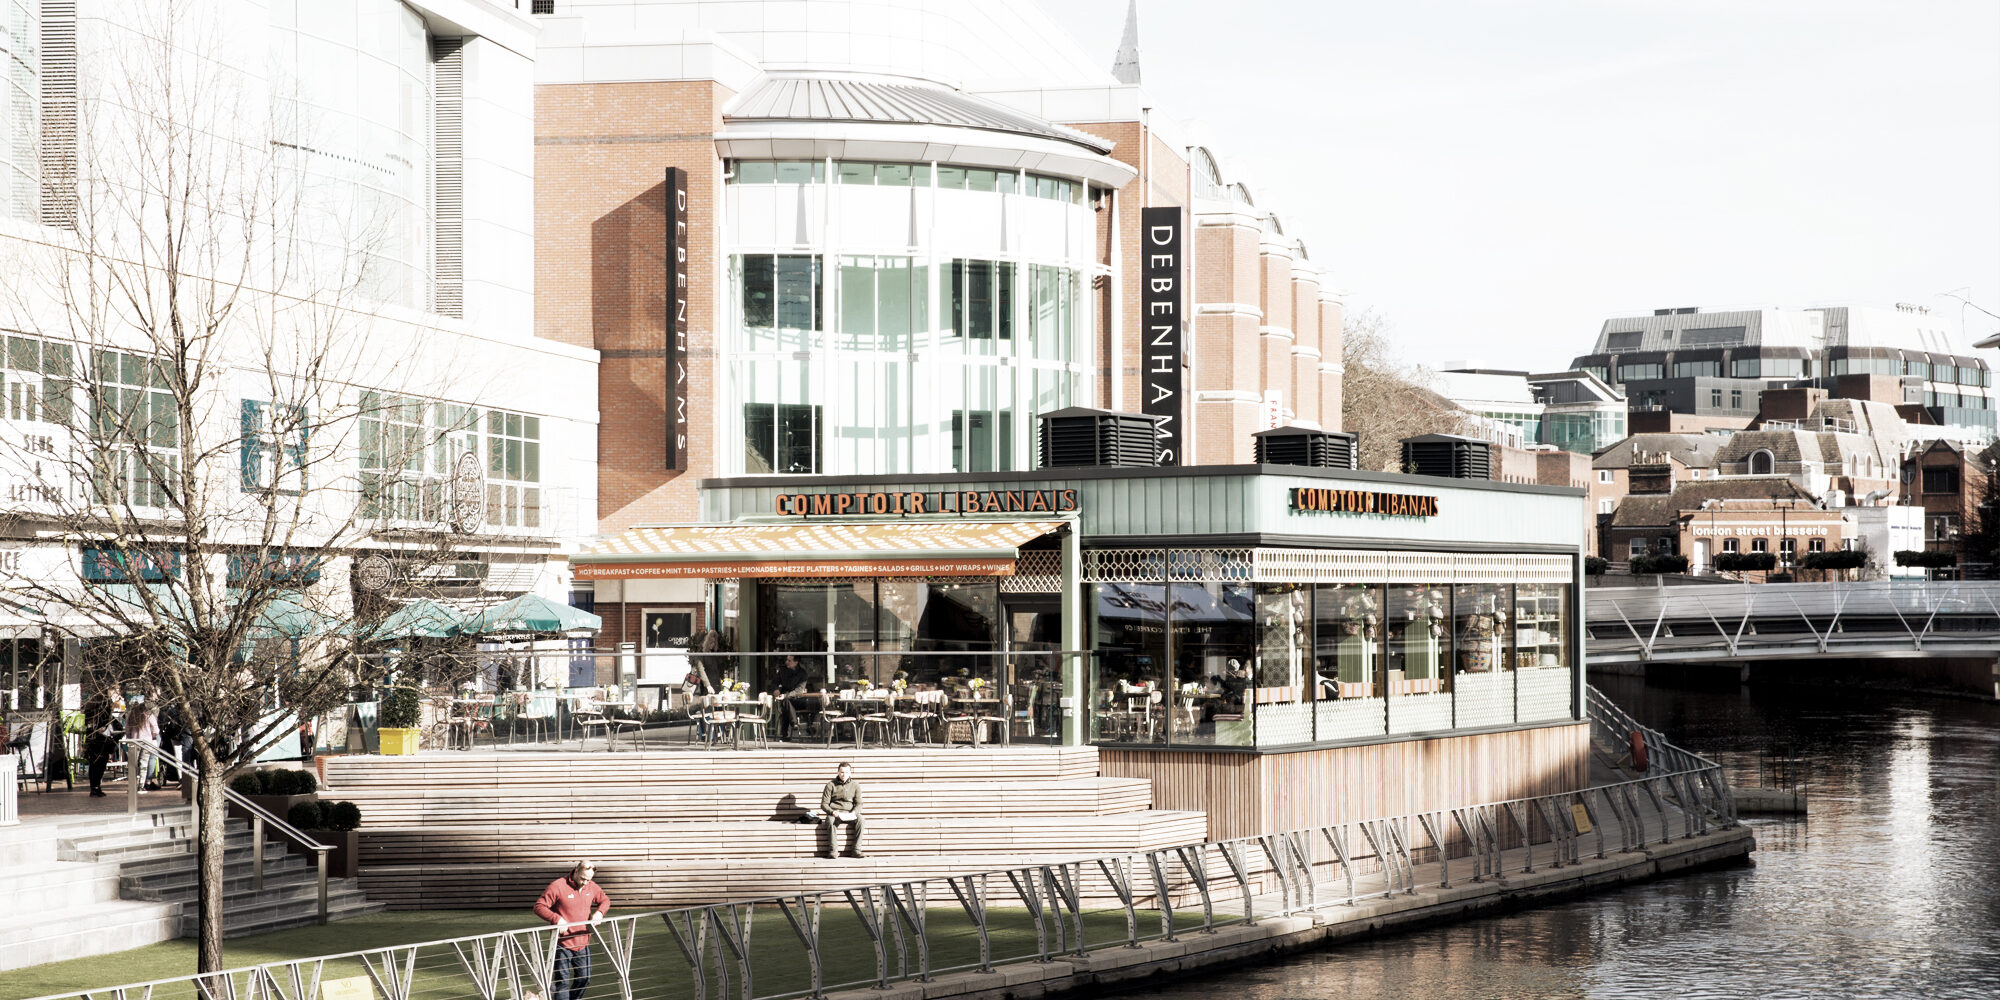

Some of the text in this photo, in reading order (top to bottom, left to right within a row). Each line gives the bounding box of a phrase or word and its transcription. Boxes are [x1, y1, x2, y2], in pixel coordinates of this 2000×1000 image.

[677, 189, 686, 449] DEBENHAMS
[1151, 225, 1173, 463] DEBENHAMS
[776, 489, 1078, 516] COMPTOIR LIBANAIS
[1298, 487, 1439, 517] COMPTOIR LIBANAIS
[1692, 525, 1828, 536] london street brasserie
[593, 568, 630, 576] BREAKFAST
[666, 567, 682, 575] MINT
[683, 567, 697, 575] TEA
[737, 566, 778, 574] LEMONADES
